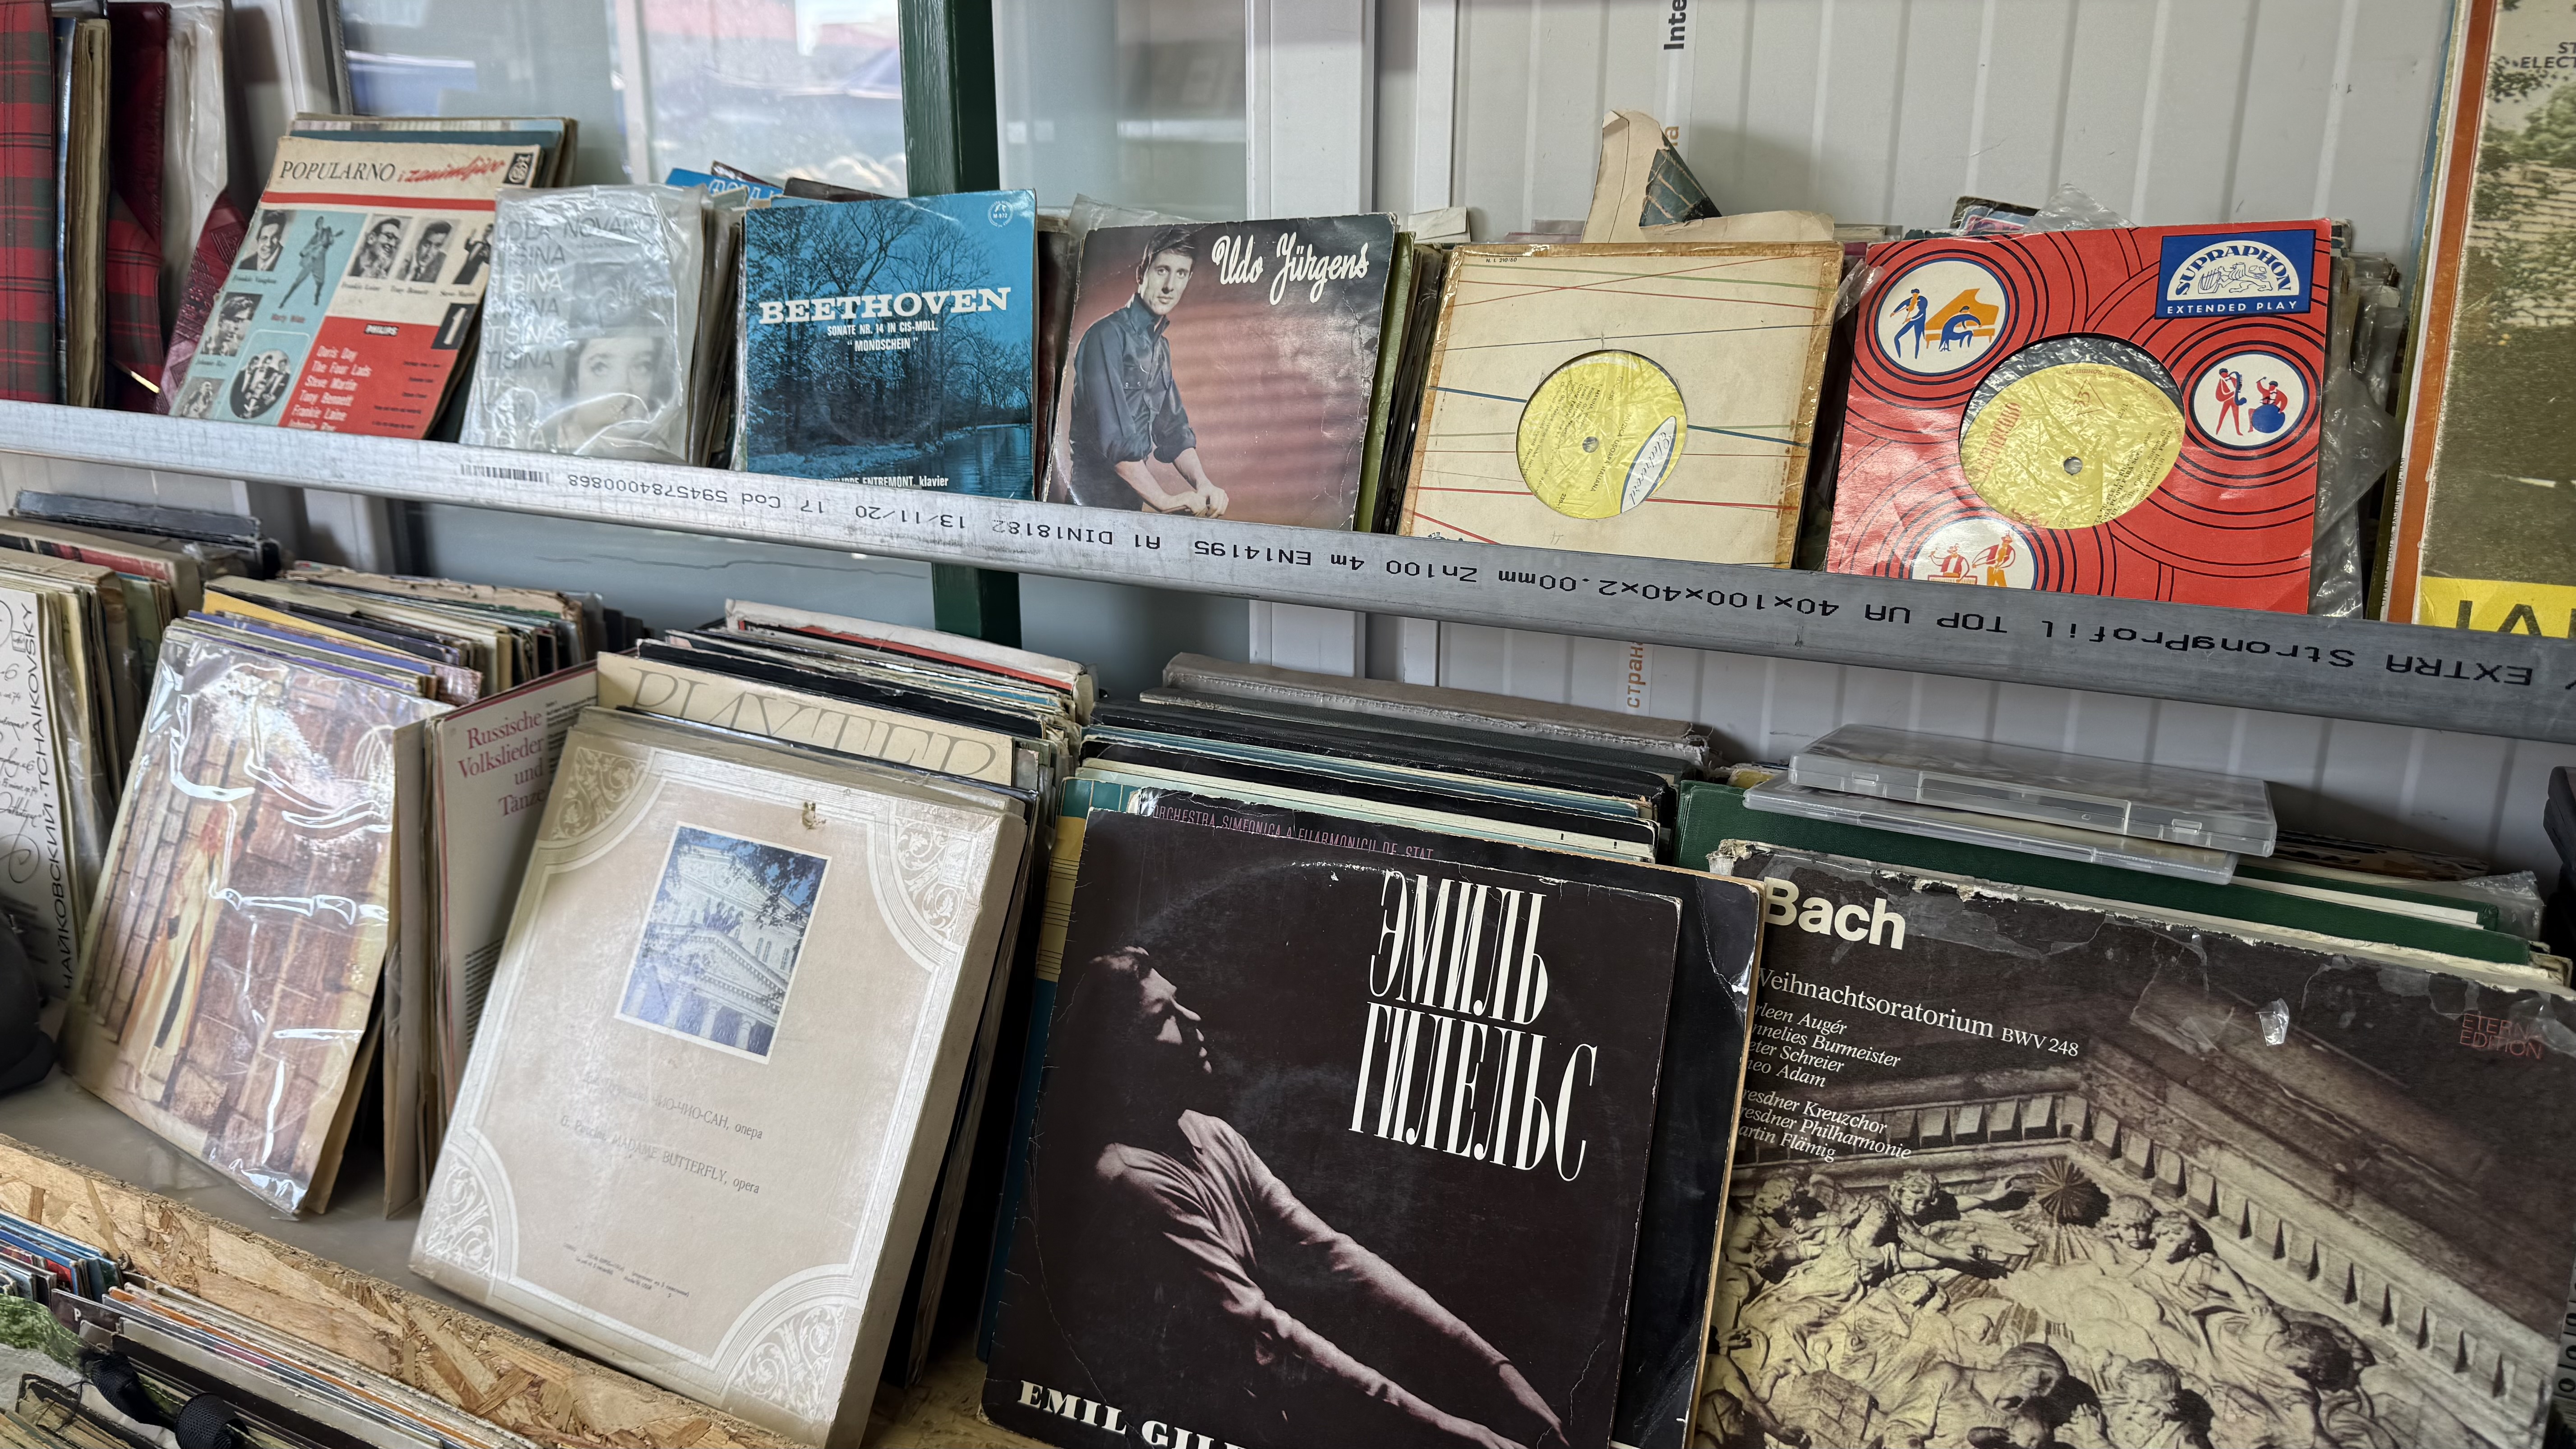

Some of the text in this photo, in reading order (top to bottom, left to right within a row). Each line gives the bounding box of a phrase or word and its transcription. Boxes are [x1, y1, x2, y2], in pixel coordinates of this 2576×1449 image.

[1664, 0, 1687, 50] Inte
[279, 161, 396, 181] POPULARNO
[1212, 232, 1370, 305] Udo Jürgens
[2175, 244, 2292, 295] SUPRAPHON
[759, 287, 1011, 324] BEETHOVEN
[2167, 300, 2298, 315] EXTENDED PLAY
[365, 324, 399, 336] PHILIPS
[827, 320, 938, 336] SONATE NR. 14 IN CIS-MOLL,
[312, 360, 373, 377] The Four Lads
[316, 345, 358, 363] Doris Day
[299, 390, 354, 406] Tony Bennett
[305, 375, 358, 391] Steve Martin
[1608, 390, 1618, 400] 230
[292, 404, 347, 421] Frankie Laine
[2158, 431, 2172, 451] Fugaru
[919, 475, 948, 487] klavier
[1629, 432, 1672, 505] Electrecord
[2146, 468, 2159, 488] Fugaru
[568, 474, 2533, 685] EXTRA StrongProfil TOP UA 40x100x40x2.00mm Zn100 4m EN14195 A1 DIN18182 13/11/20 17 Cod 5945784000868
[1627, 642, 1646, 708] стран
[467, 711, 542, 750] Russische
[458, 737, 544, 778] Volkslieder
[514, 757, 543, 785] und
[22, 603, 74, 989] ЧАЙКОВСКИЙ TCHAIKOVSKY
[498, 789, 546, 816] Tänze
[1153, 805, 1215, 828] ORCHESTRA
[1406, 846, 1435, 859] STAT
[1764, 877, 1905, 950] Bach
[1369, 869, 1549, 1025] ЭМИЛЬ
[1755, 1003, 1848, 1035] rleen Augér
[1749, 1040, 1845, 1073] eter Schreier
[1752, 1023, 1901, 1068] nnelies Burmeister
[2001, 1027, 2047, 1049] BWV
[2047, 1038, 2079, 1057] 248
[2460, 1030, 2542, 1059] EDITION
[1349, 1001, 1598, 1182] ГИЛЕЛЬС
[1776, 1065, 1826, 1088] Adam
[652, 1095, 763, 1140] ЧИО-ЧИО-САН, опера
[1742, 1088, 1888, 1135] resdner Kreuzchor
[1738, 1126, 1836, 1164] artin Flämig
[1740, 1106, 1912, 1159] resdner Philharmonie
[612, 1134, 658, 1159] MADAME
[662, 1150, 727, 1185] BUTTERFLY,
[733, 1178, 760, 1194] opera
[1017, 1380, 1249, 1449] EMIL GIL
